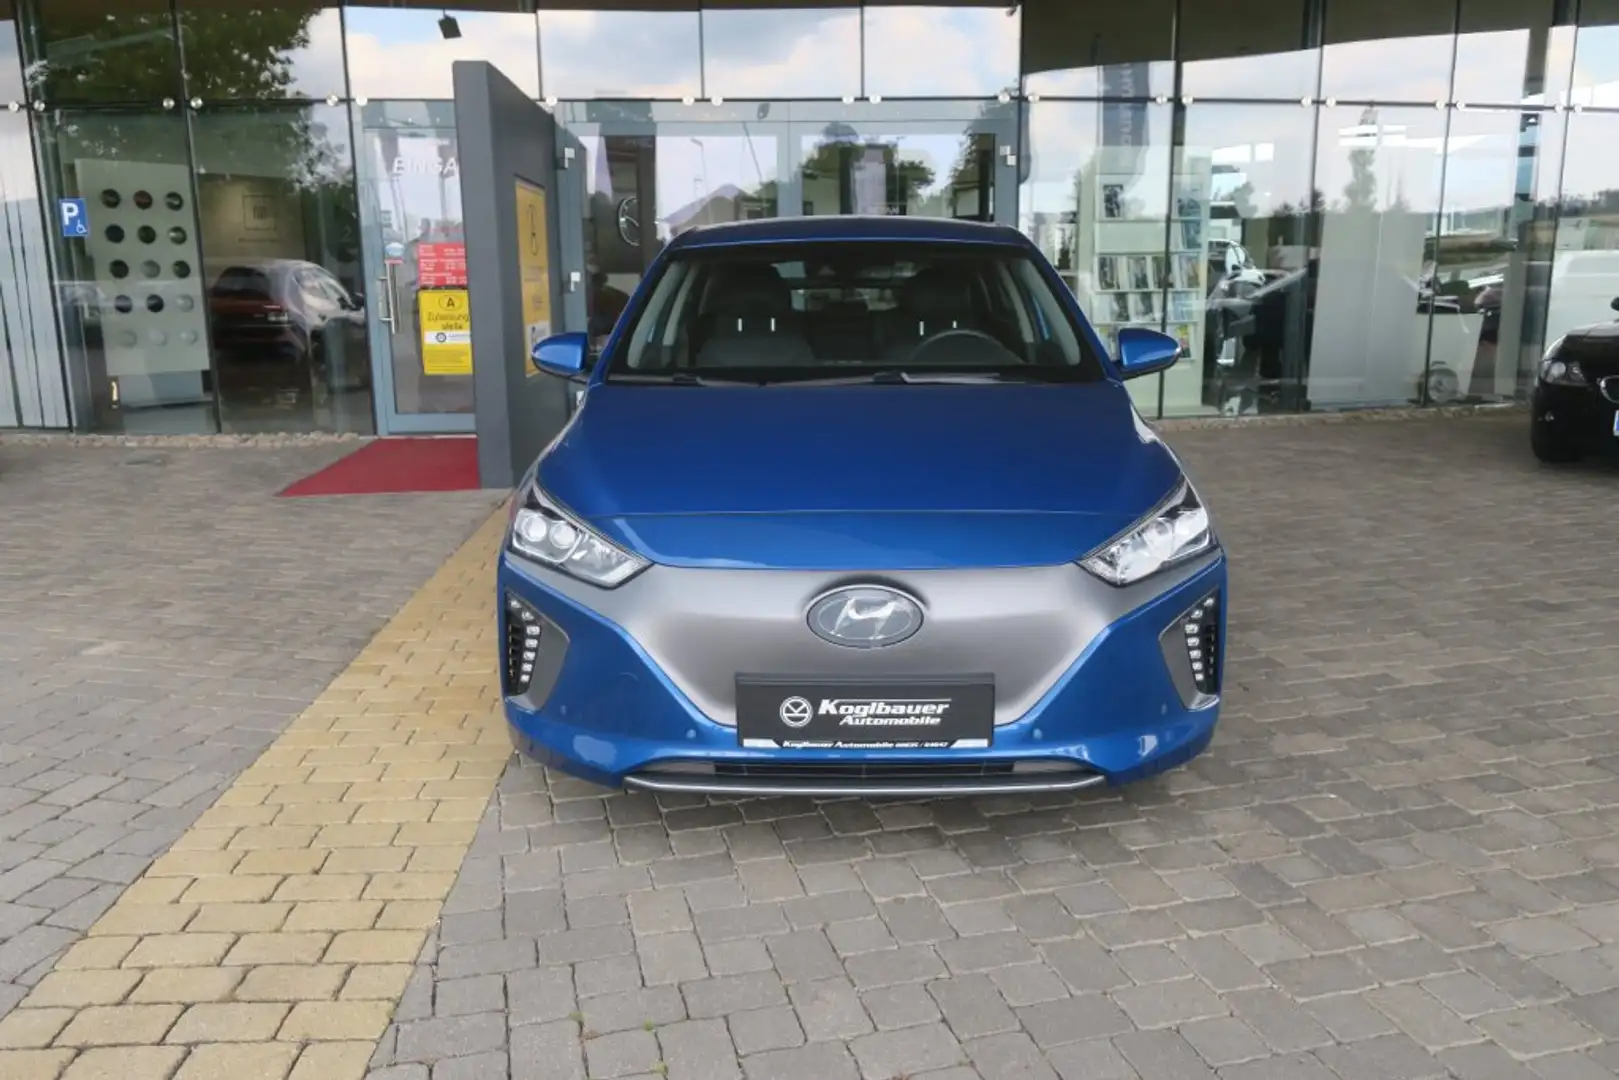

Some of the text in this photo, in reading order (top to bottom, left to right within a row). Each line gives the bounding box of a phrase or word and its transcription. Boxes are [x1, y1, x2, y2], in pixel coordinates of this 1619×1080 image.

[61, 202, 79, 226] P
[818, 698, 951, 717] Koglbauer
[839, 715, 941, 726] Automobile
[782, 740, 834, 750] Koglbauer
[834, 741, 895, 749] Automobile
